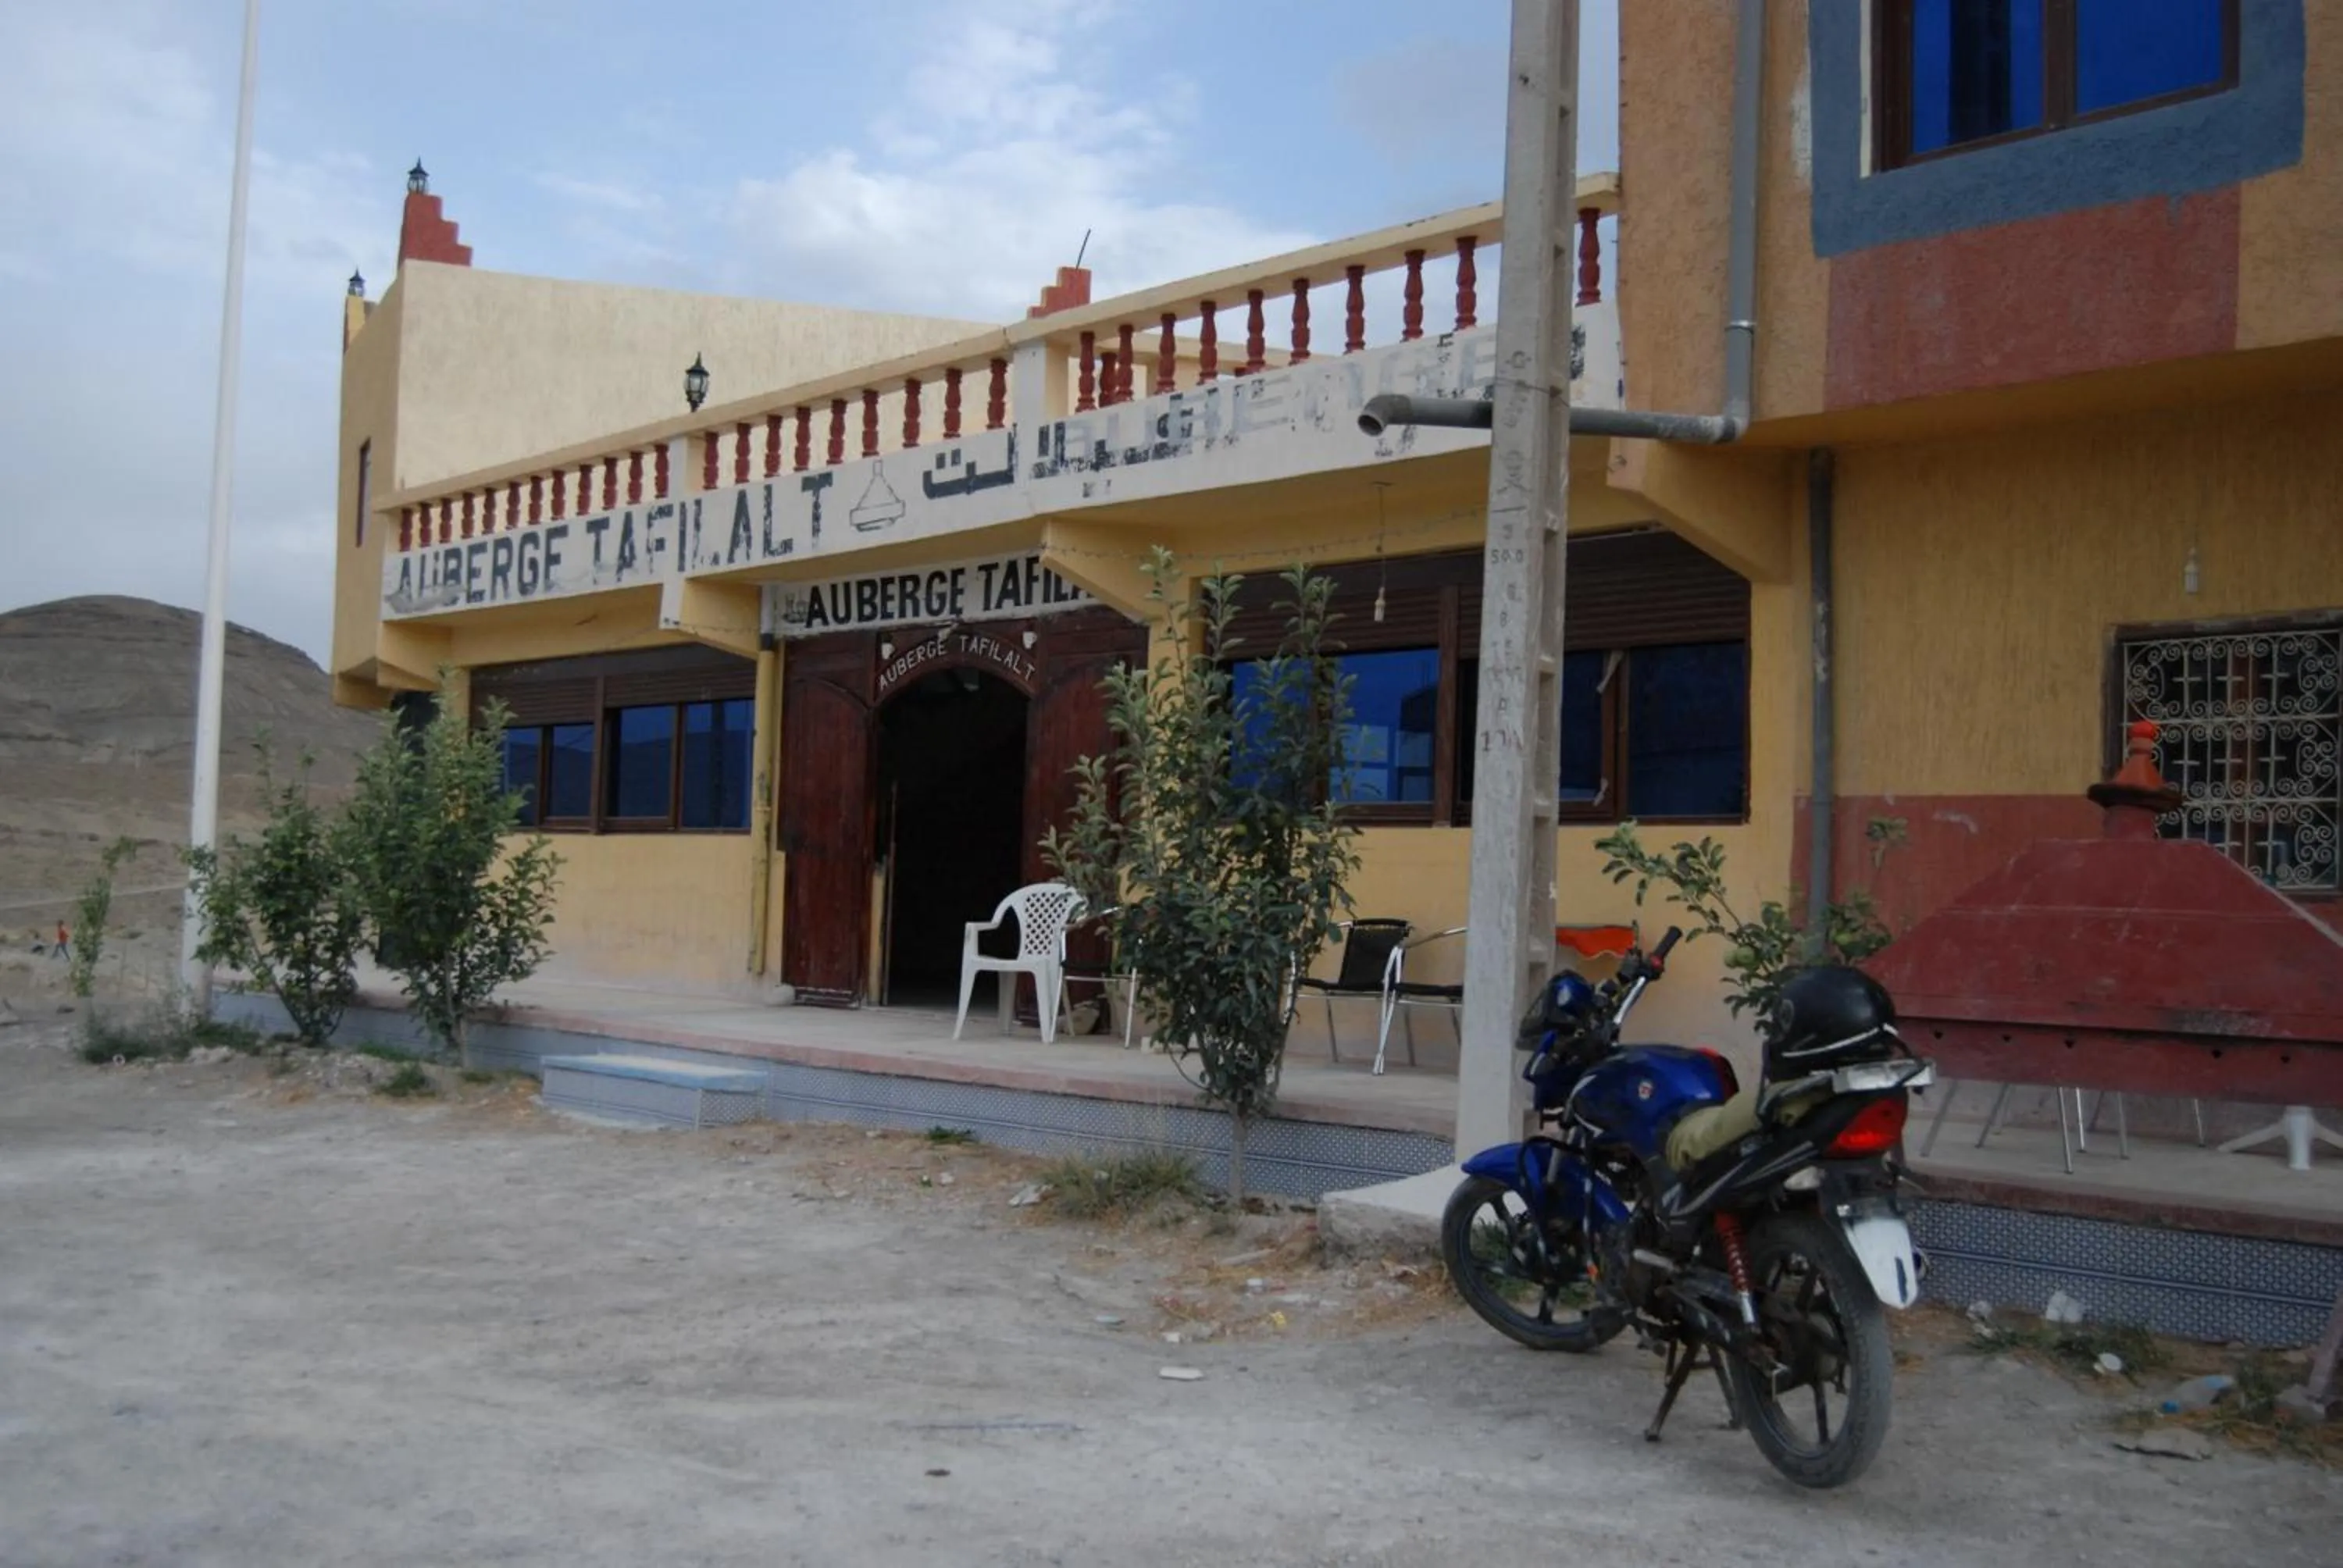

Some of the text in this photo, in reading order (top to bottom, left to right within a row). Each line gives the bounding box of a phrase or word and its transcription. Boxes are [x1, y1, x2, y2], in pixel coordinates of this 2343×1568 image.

[398, 471, 834, 605] AUBERGE TAFILALT
[805, 567, 965, 629] AUBERGE
[879, 635, 1036, 691] AUBERGE TAFILALT
